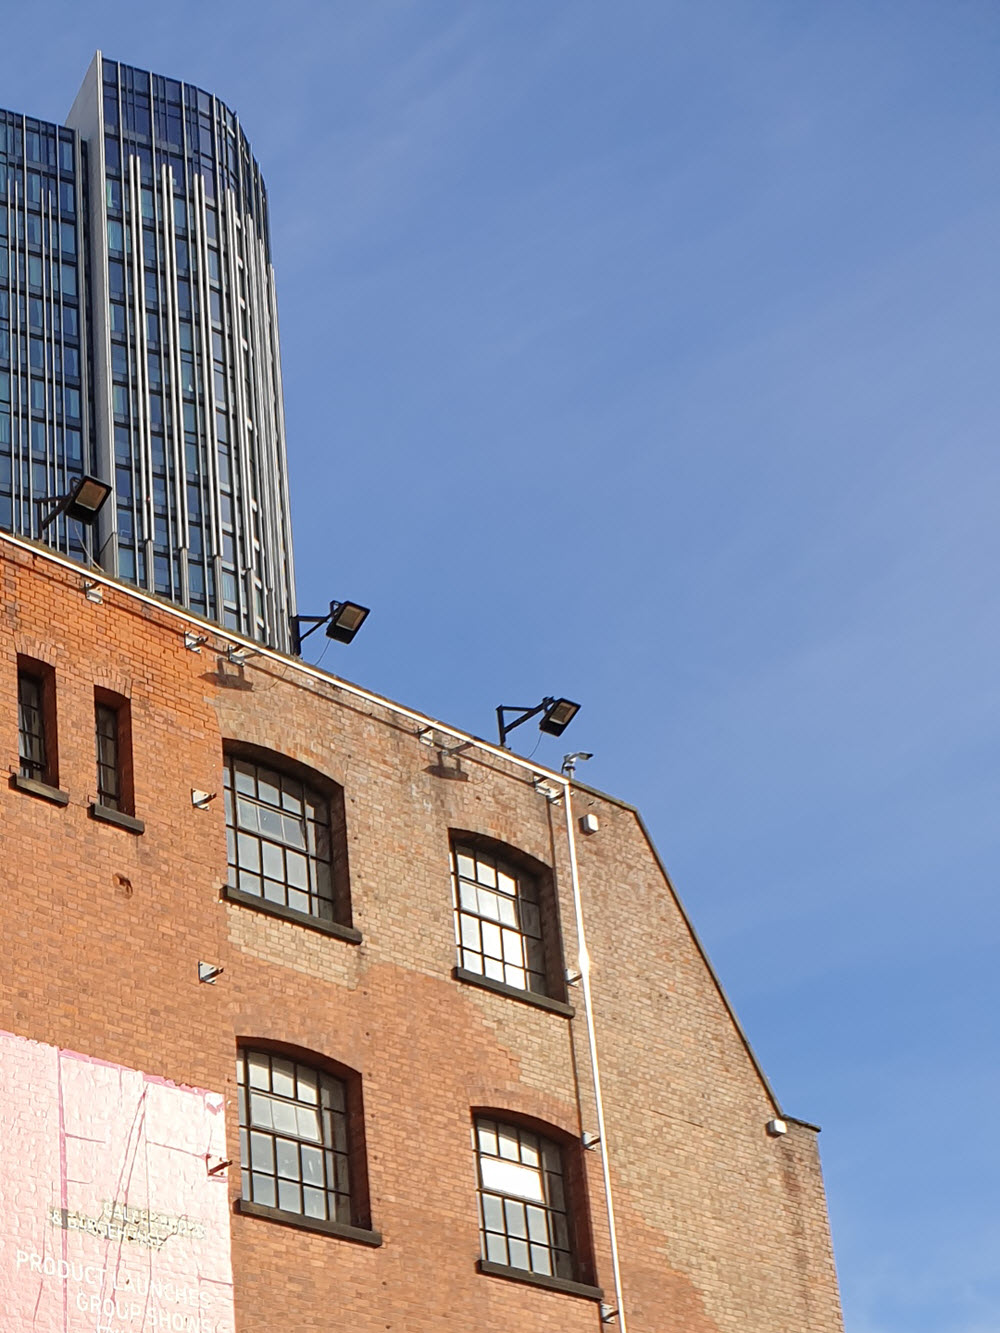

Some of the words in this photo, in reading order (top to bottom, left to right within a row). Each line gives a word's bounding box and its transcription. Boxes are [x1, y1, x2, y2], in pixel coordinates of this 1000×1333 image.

[16, 1249, 106, 1286] PRODUCT
[113, 1268, 211, 1310] LAUNCHES
[76, 1292, 141, 1321] GROUP
